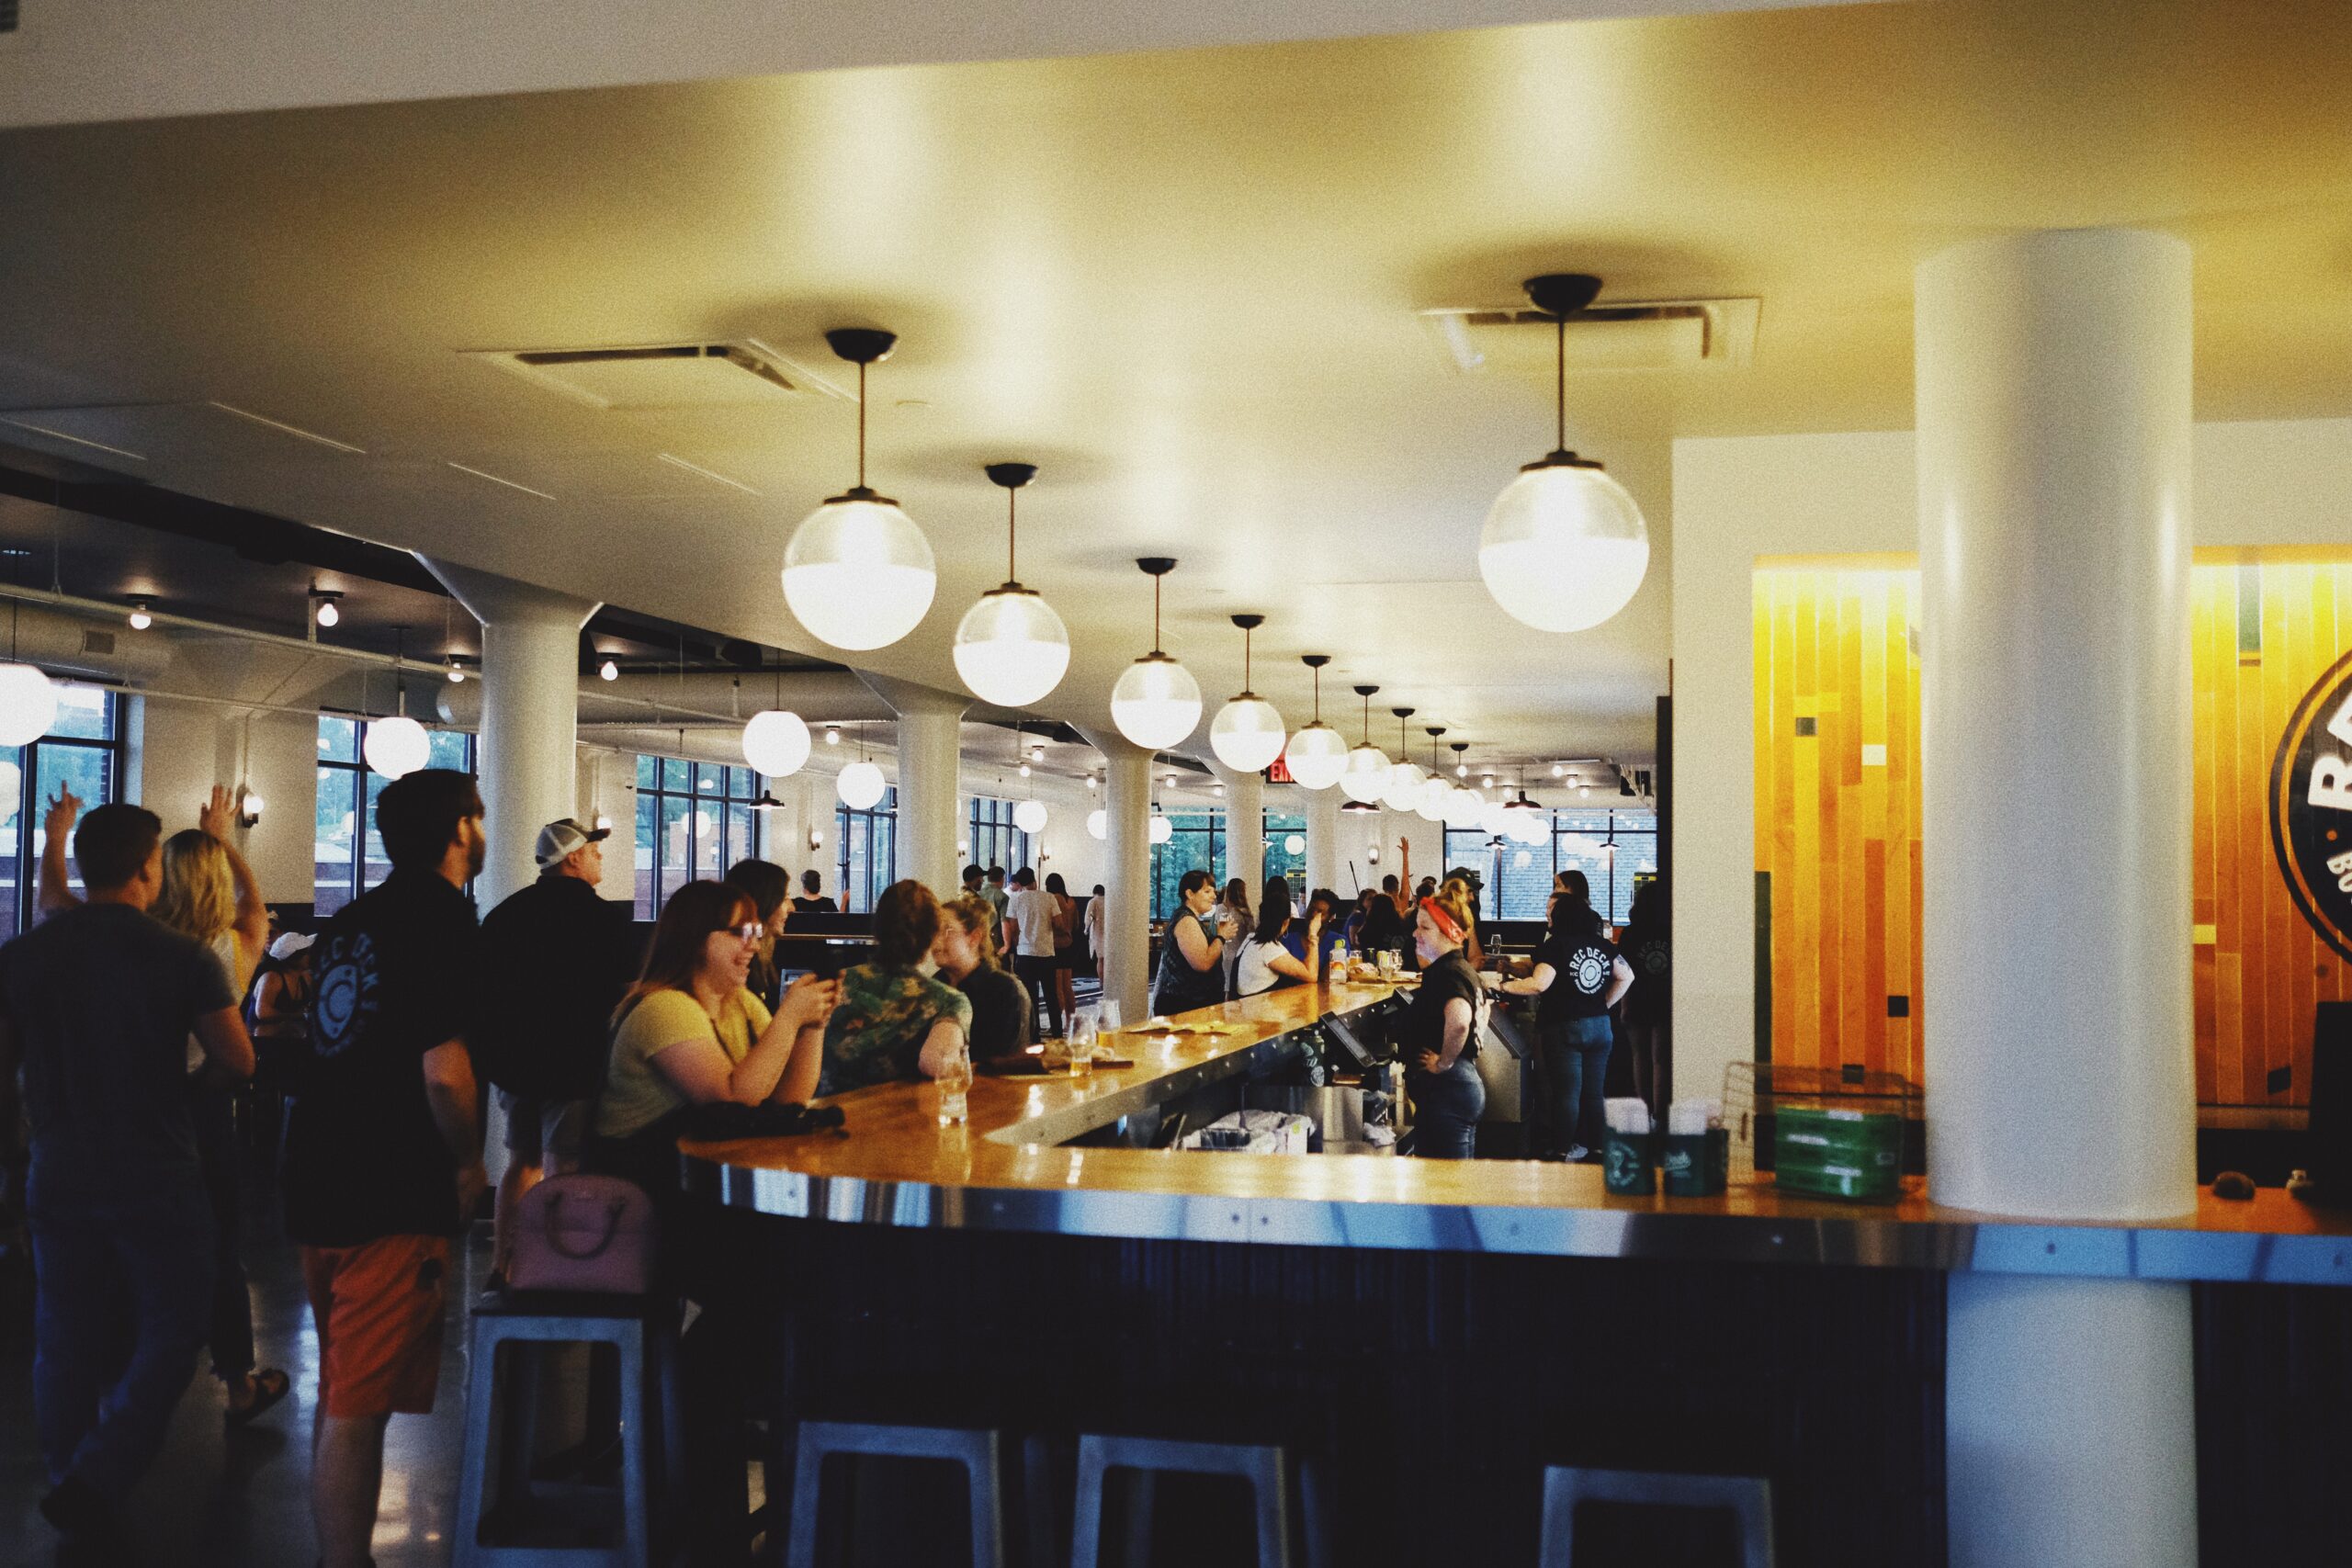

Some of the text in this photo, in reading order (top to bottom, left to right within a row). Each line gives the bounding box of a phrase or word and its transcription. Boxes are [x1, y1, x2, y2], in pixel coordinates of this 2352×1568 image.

[1271, 763, 1294, 782] EXI
[1569, 947, 1611, 970] REC DECK
